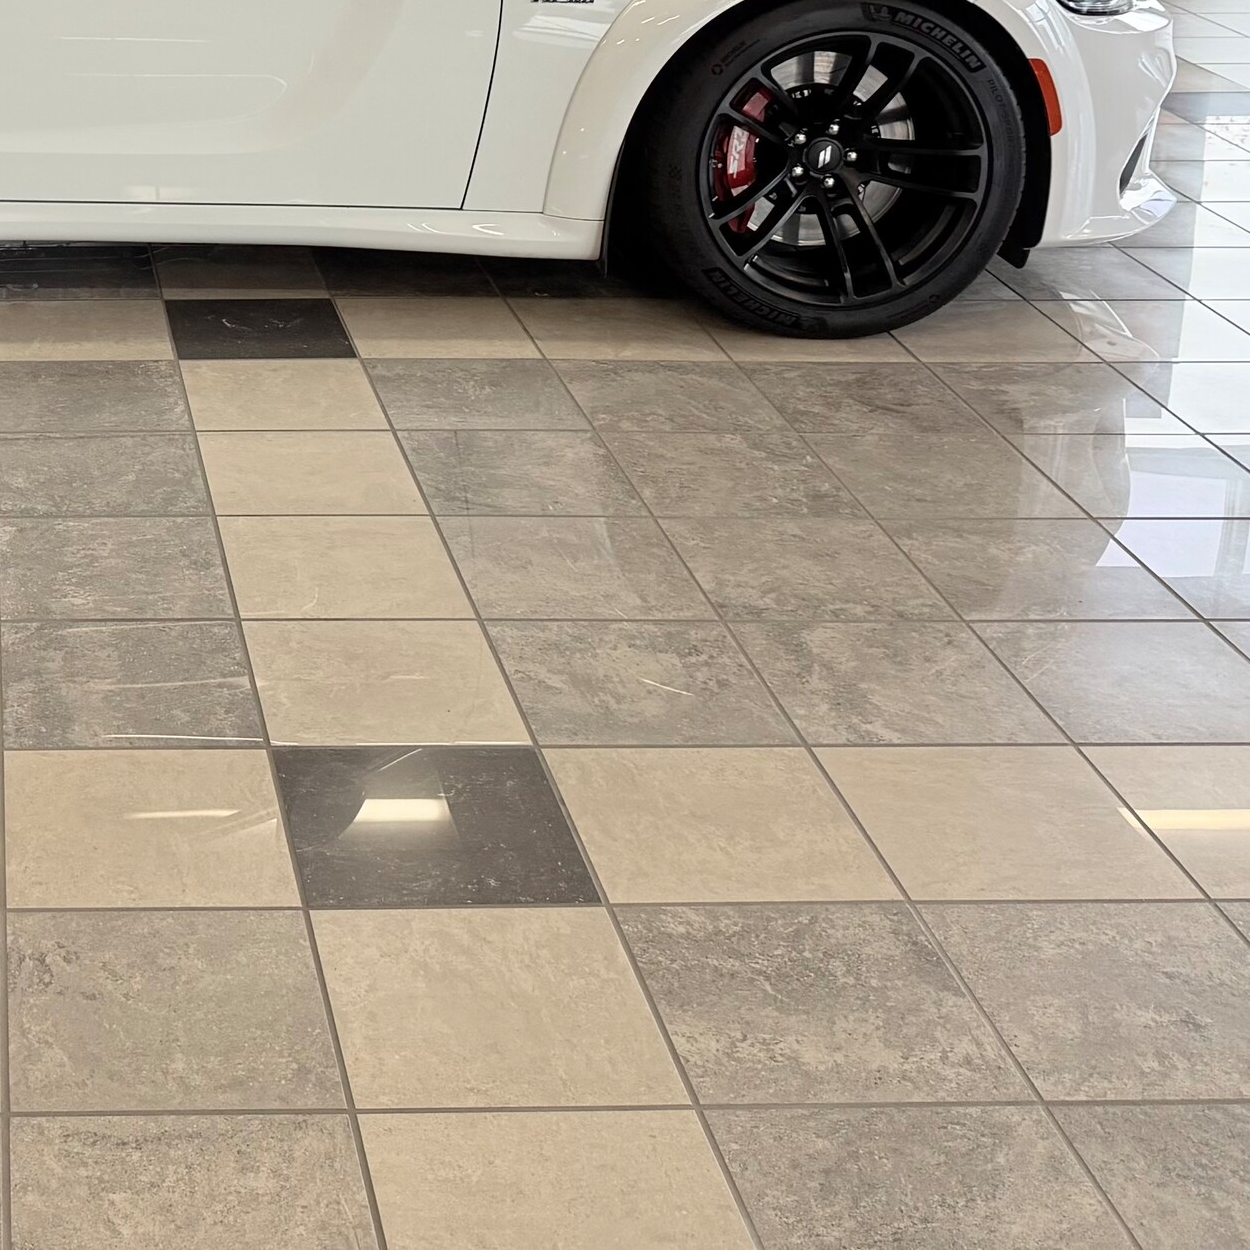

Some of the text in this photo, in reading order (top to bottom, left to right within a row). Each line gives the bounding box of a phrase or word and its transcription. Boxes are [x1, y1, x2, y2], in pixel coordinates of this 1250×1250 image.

[894, 11, 981, 71] MICHELIN
[987, 78, 1006, 110] PILOT
[705, 268, 798, 328] MICHELIN
